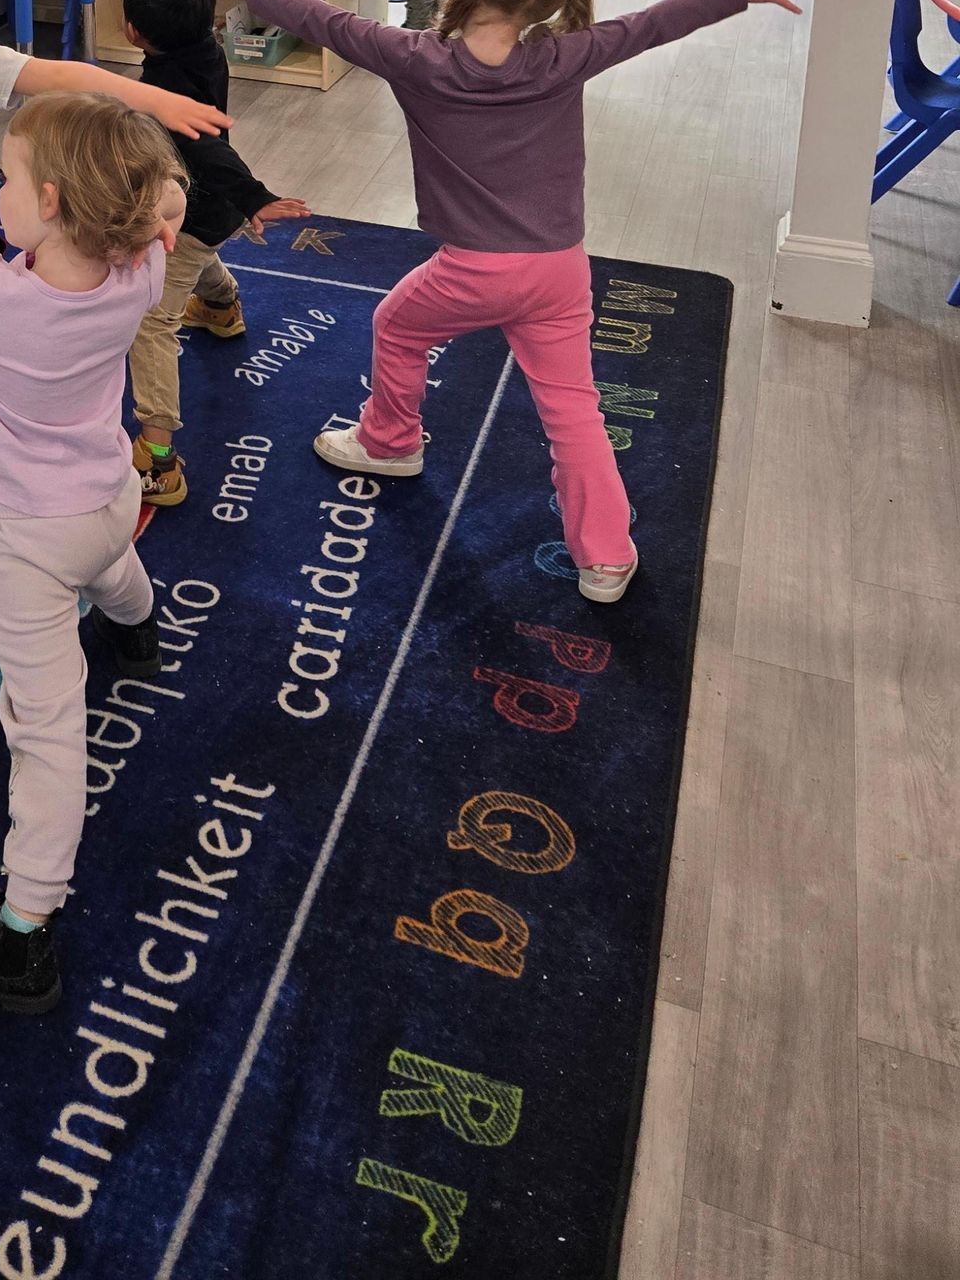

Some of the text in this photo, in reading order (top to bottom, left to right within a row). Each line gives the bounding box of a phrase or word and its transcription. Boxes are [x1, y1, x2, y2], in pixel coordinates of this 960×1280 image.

[235, 308, 336, 387] amable
[212, 434, 273, 523] emab
[277, 472, 382, 719] caridade
